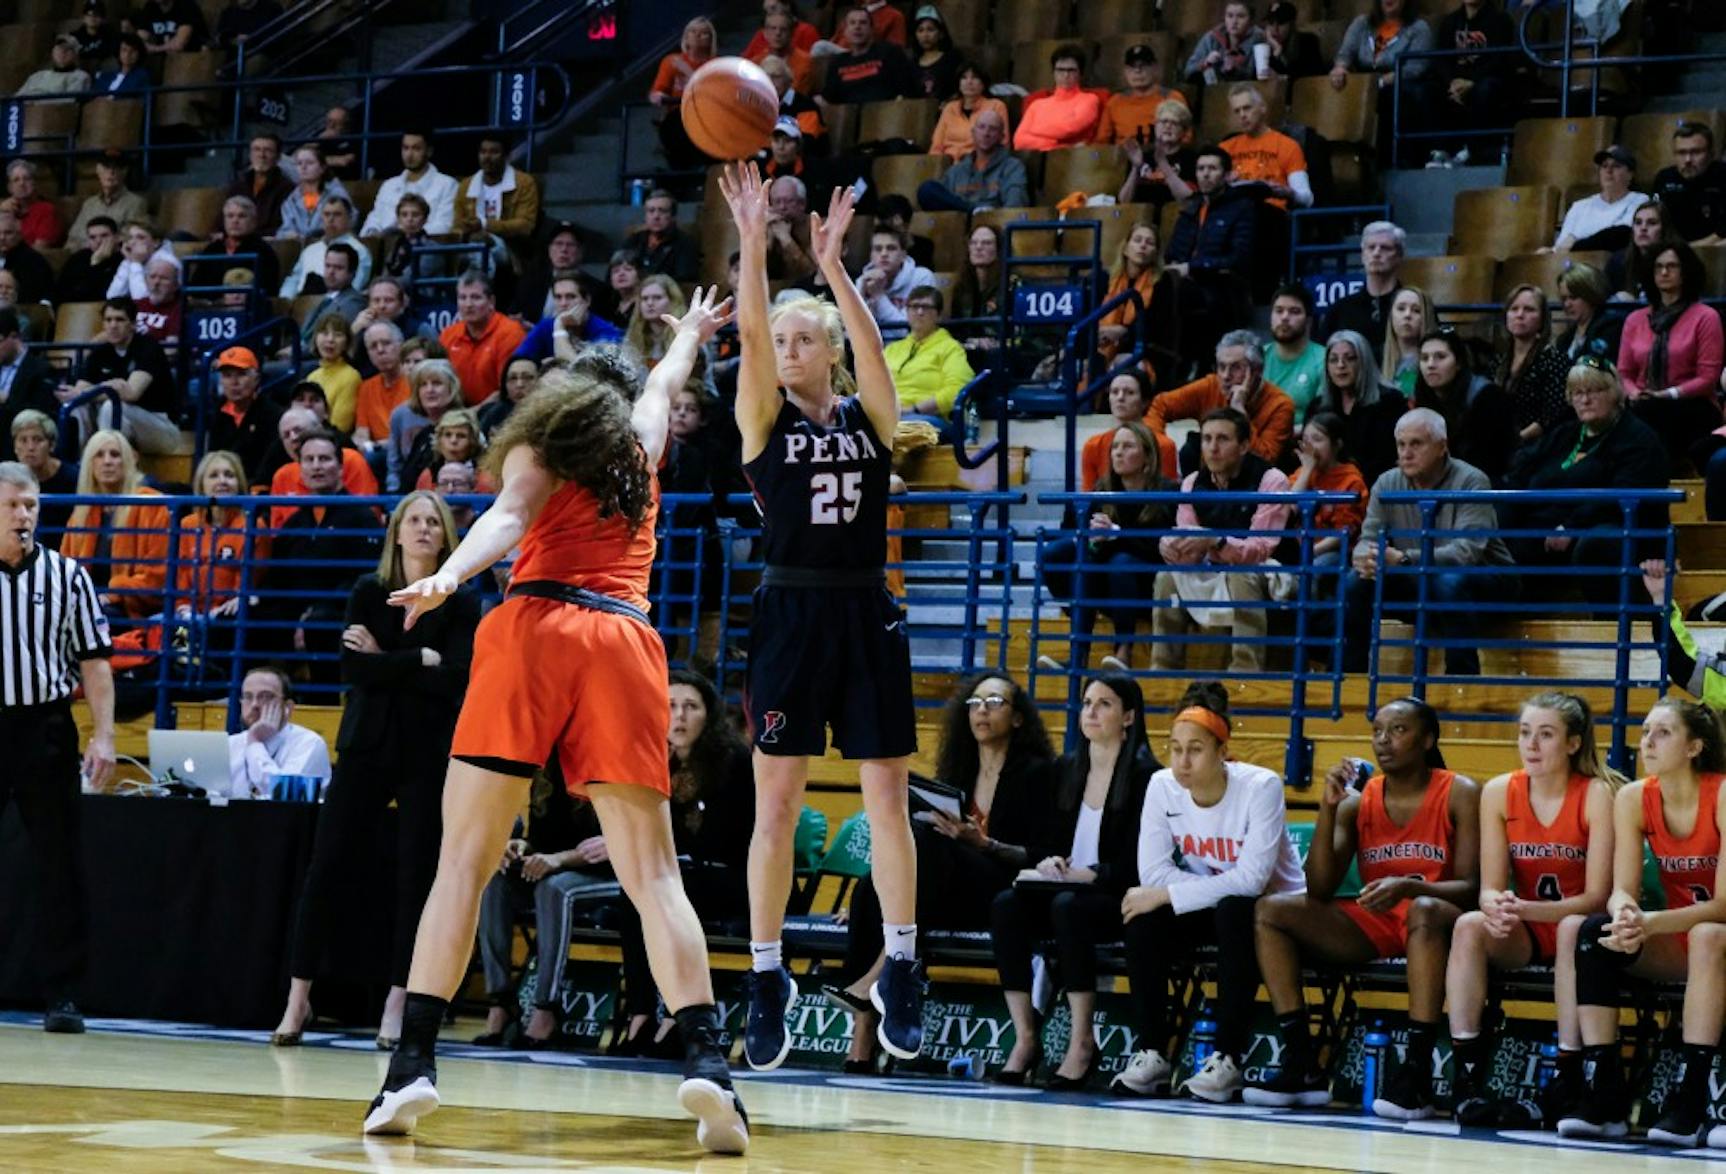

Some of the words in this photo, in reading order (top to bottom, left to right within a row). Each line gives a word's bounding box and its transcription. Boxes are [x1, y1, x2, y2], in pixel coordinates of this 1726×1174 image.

[260, 97, 287, 121] 202
[511, 73, 524, 121] 203
[7, 105, 19, 150] 203
[1026, 291, 1073, 317] 104
[198, 317, 237, 340] 103
[784, 429, 878, 465] PENN
[810, 471, 863, 525] 25
[760, 710, 786, 744] P
[1509, 843, 1587, 861] RINCETON
[1536, 873, 1564, 902] 4
[559, 990, 609, 1021] VY
[804, 993, 830, 1006] THE
[947, 1003, 975, 1016] THE
[793, 1005, 855, 1038] IVY
[935, 1015, 1014, 1049] IVY
